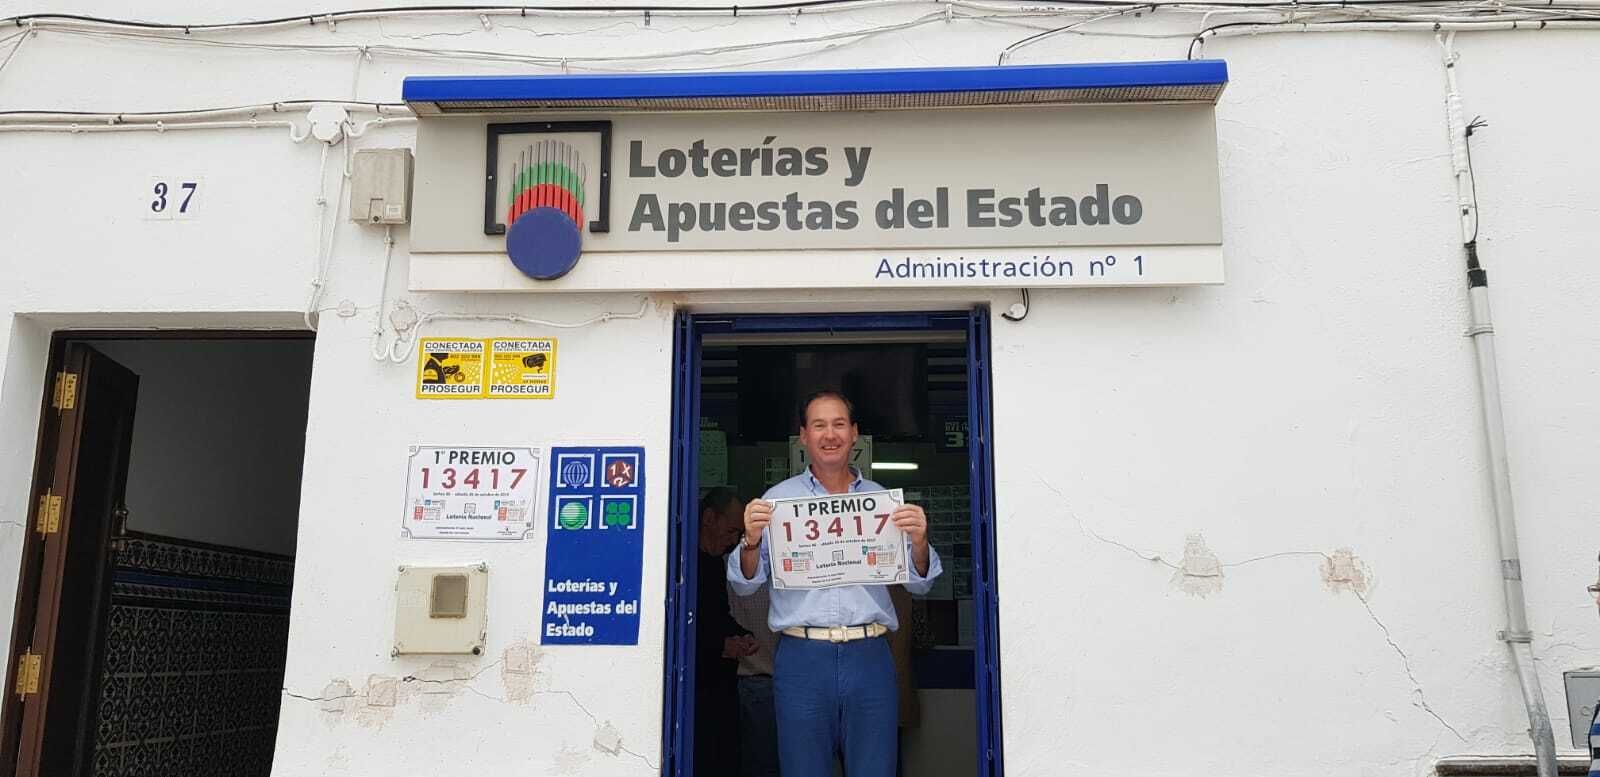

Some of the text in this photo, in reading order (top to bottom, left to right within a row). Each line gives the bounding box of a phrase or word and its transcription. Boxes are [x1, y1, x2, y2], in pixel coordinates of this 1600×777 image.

[629, 136, 872, 187] Loterías y
[151, 182, 197, 213] 37
[628, 183, 1143, 242] Apuestas del Estado
[875, 255, 1144, 279] Administración nº 1
[494, 341, 551, 349] CONECTADA
[421, 385, 480, 393] PROSEGUR
[491, 385, 549, 393] PROSEGUR
[449, 450, 516, 465] PREMIO
[421, 468, 528, 490] 13417
[808, 498, 876, 516] PREMIO
[782, 513, 890, 542] 13417
[548, 578, 618, 595] Loterías y
[547, 600, 637, 617] Apuestas del
[546, 623, 594, 637] Estado
